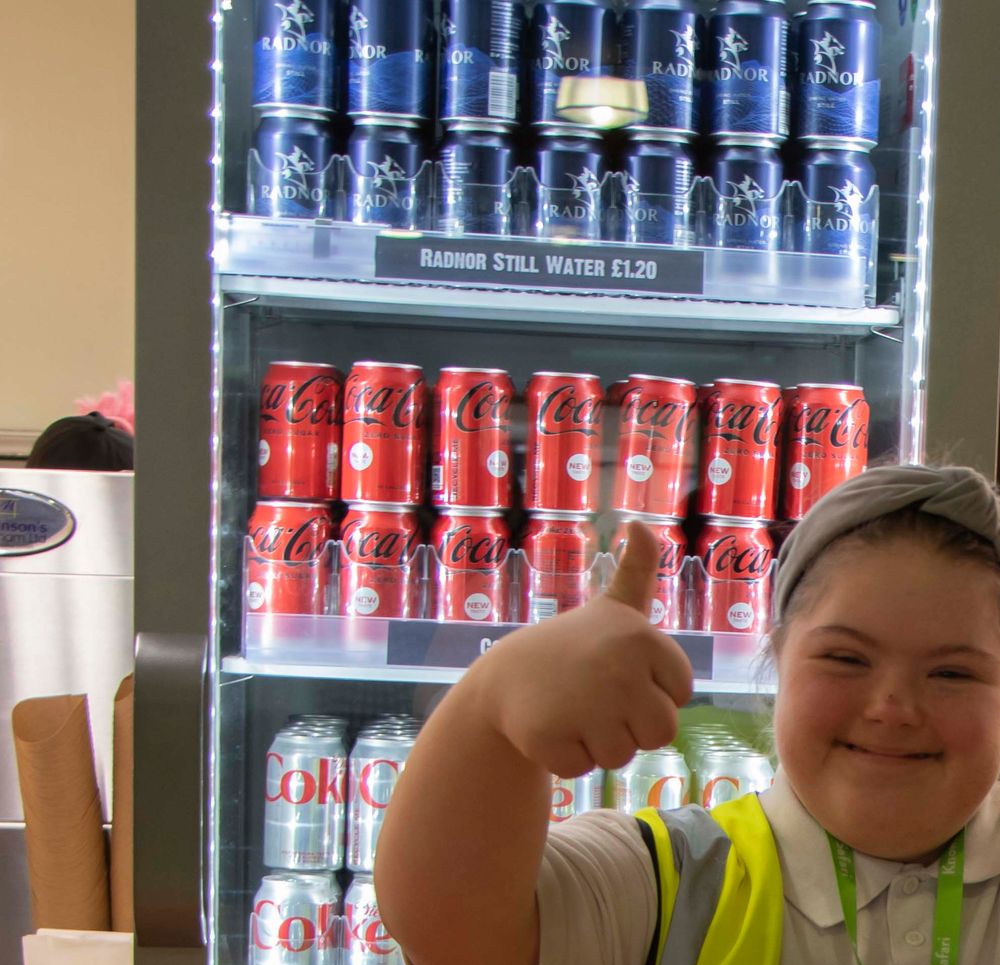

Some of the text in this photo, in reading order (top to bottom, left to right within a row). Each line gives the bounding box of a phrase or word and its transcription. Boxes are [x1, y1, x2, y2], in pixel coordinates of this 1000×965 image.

[261, 36, 332, 56] RADNOR
[420, 247, 658, 281] RADNOR STILL WATER £1.20
[710, 466, 730, 475] NEW
[466, 602, 490, 610] NEW
[729, 611, 752, 619] NEW
